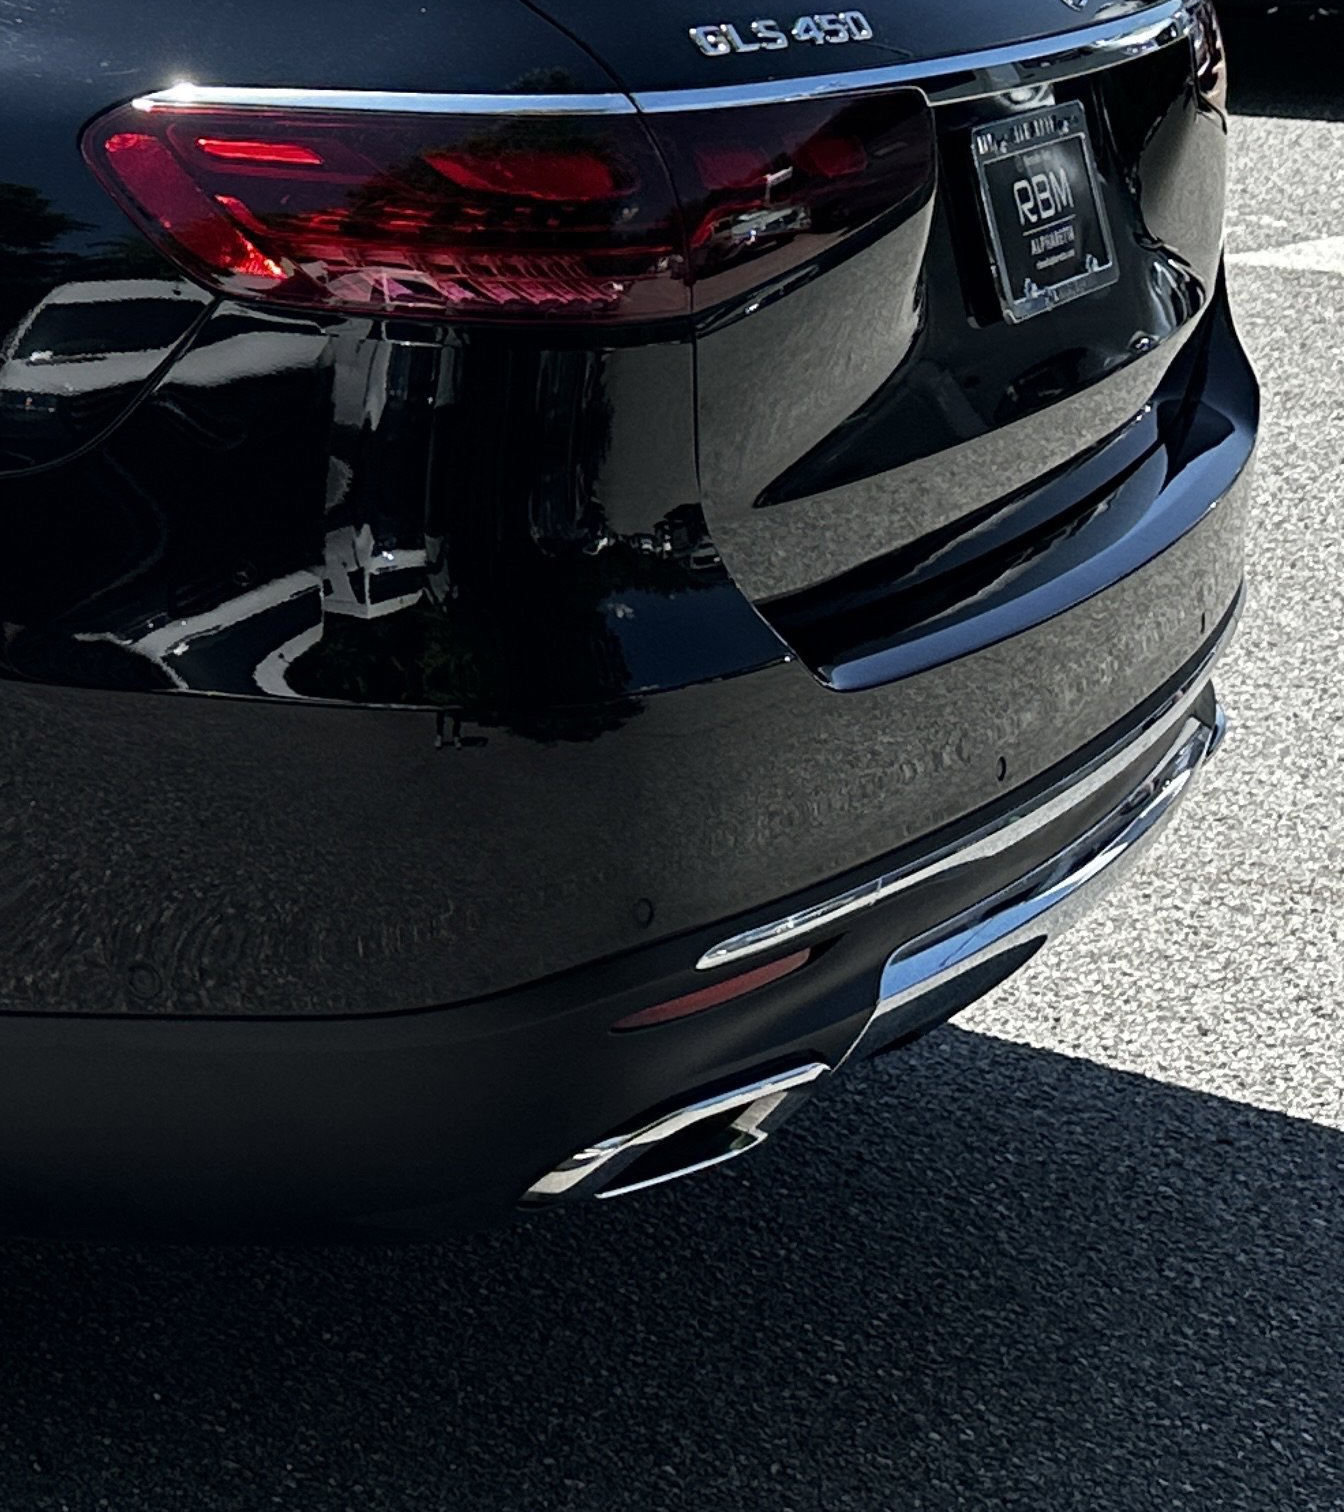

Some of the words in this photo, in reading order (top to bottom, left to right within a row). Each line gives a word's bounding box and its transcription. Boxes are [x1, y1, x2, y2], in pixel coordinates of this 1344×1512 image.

[688, 19, 789, 56] GLS
[791, 10, 874, 45] 450
[1013, 168, 1074, 225] RBM
